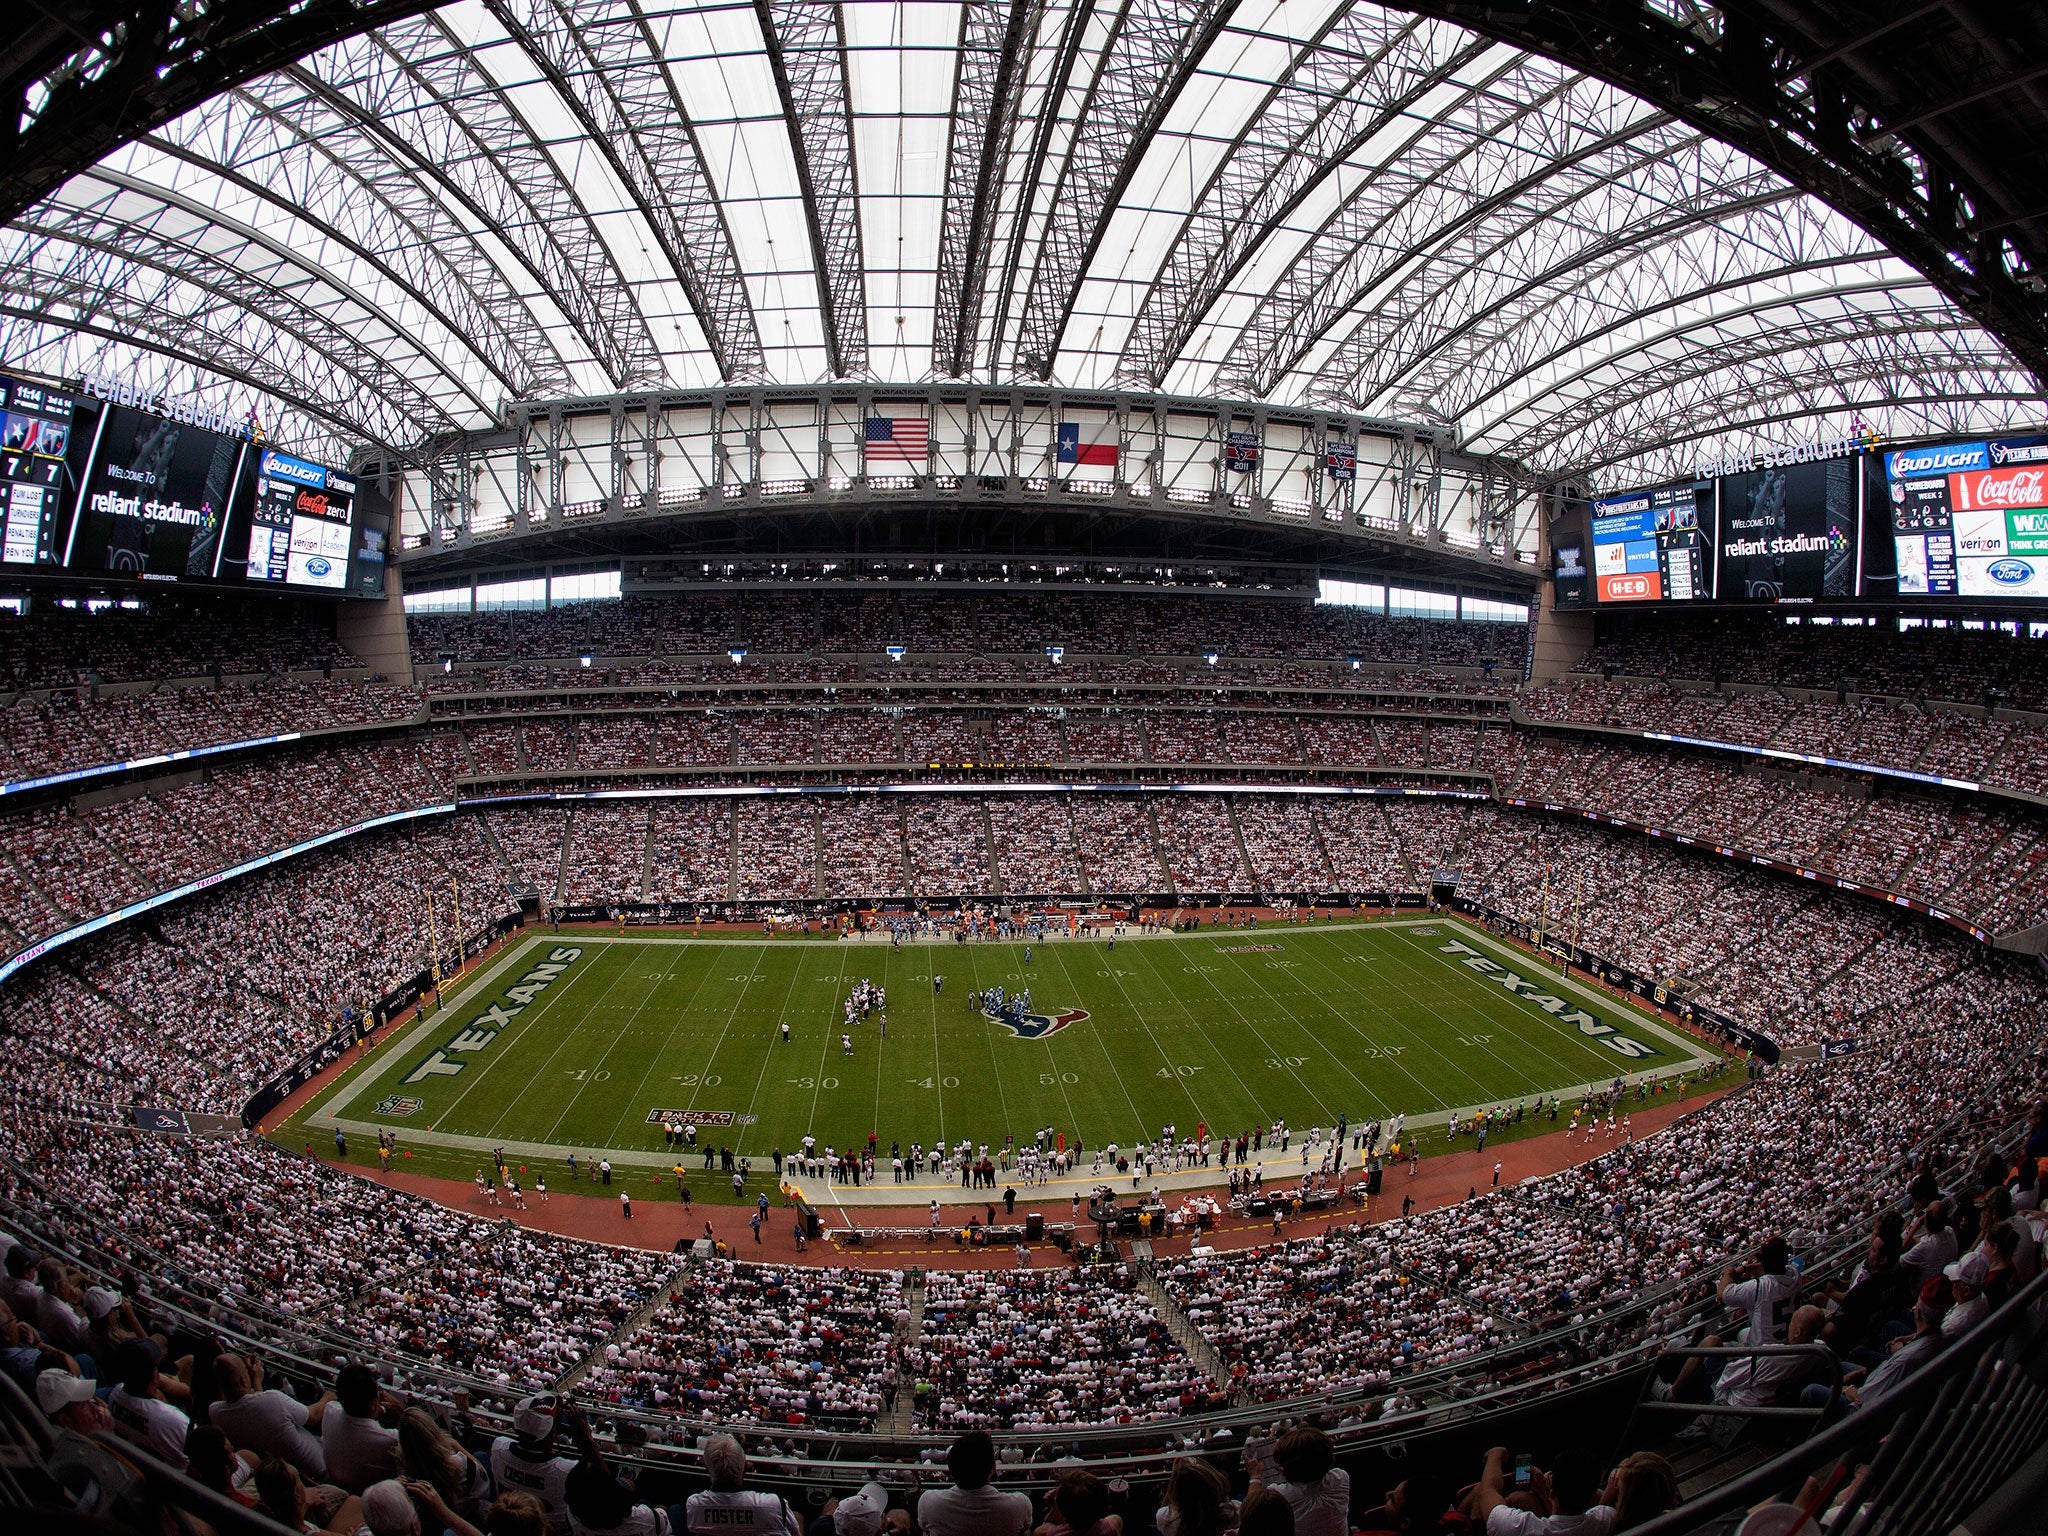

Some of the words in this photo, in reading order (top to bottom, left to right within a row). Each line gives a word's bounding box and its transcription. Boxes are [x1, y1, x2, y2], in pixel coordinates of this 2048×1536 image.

[83, 371, 157, 412] reliant
[160, 394, 241, 438] stadium
[1228, 438, 1258, 446] CHAMPIONS
[1328, 446, 1355, 455] CHAMPIONS
[1694, 451, 1757, 480] reliant
[1763, 437, 1850, 468] stadium
[1900, 455, 1934, 472] BUD
[1934, 451, 1984, 469] LIGHT
[8, 457, 19, 476] 7
[269, 459, 292, 475] BUD
[292, 466, 323, 483] LIGHT
[1233, 461, 1249, 471] 2011
[47, 464, 58, 482] 7
[1335, 469, 1351, 478] 2012
[1905, 479, 1946, 492] SCOREBOARD
[1977, 471, 2044, 507] Coca-Cola
[1654, 490, 1671, 500] 11:14
[90, 490, 141, 517] reliant
[143, 499, 201, 526] stadium
[1732, 519, 1764, 529] WELCOME
[1909, 520, 1919, 528] 14
[8, 527, 37, 540] PENALTIES
[1688, 533, 1695, 545] 7
[294, 537, 318, 551] verizon
[1661, 535, 1668, 548] 7
[1725, 537, 1768, 557] reliant
[1771, 533, 1829, 554] stadium
[1960, 537, 2001, 552] verizon
[2010, 539, 2033, 550] THINK
[5, 547, 19, 557] PEN
[21, 548, 35, 559] YDS
[1628, 553, 1650, 561] UNITED
[311, 562, 326, 574] Ford
[1997, 563, 2023, 580] Ford
[343, 825, 363, 834] TEXANS
[196, 874, 224, 889] TEXANS
[14, 944, 46, 965] TEXANS
[1437, 938, 1664, 1059] TEXANS
[1656, 990, 1665, 1001] 36
[364, 1015, 373, 1028] 36
[398, 945, 583, 1085] TEXANS
[1456, 1034, 1489, 1047] 10
[1364, 1046, 1401, 1059] 20
[1264, 1056, 1304, 1069] 30
[571, 1069, 612, 1082] 10
[1155, 1065, 1195, 1079] 40
[680, 1075, 722, 1087] 20
[797, 1077, 840, 1089] 30
[917, 1076, 960, 1089] 40
[1039, 1073, 1079, 1085] 50
[659, 1117, 728, 1125] FOOTBALL
[662, 1111, 702, 1119] BACK
[504, 1465, 545, 1490] CUSHING
[704, 1509, 754, 1525] FOSTER
